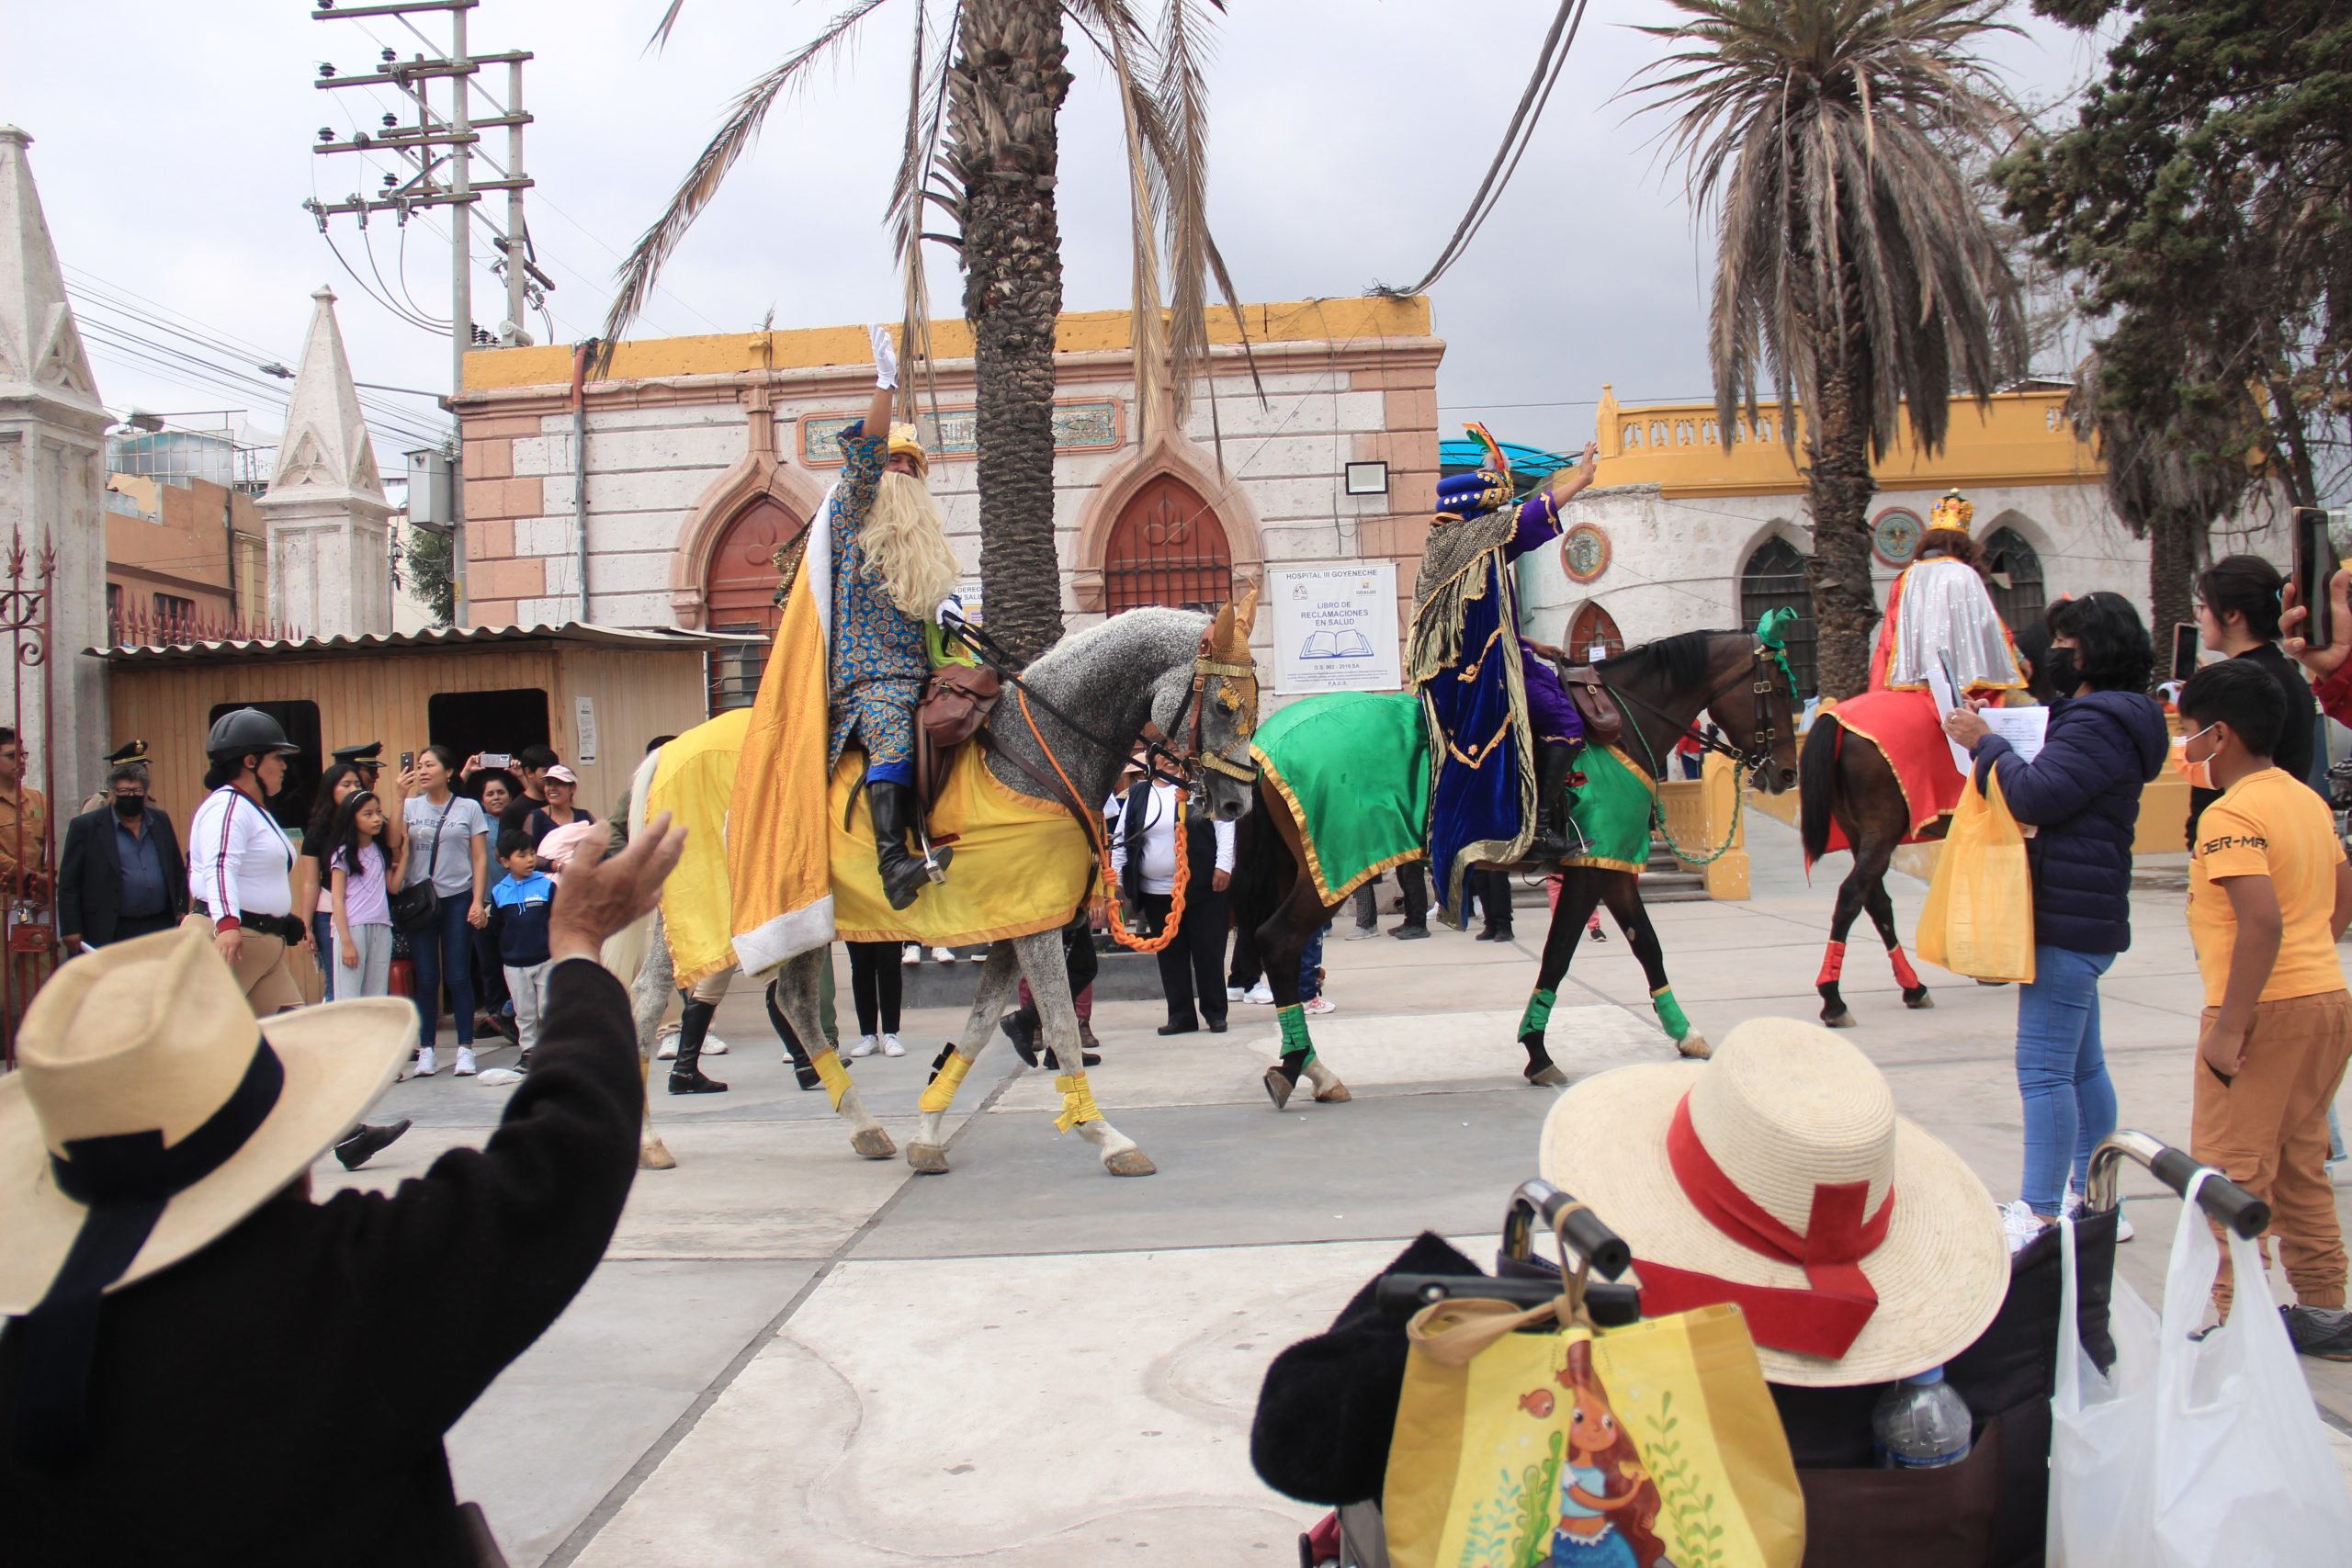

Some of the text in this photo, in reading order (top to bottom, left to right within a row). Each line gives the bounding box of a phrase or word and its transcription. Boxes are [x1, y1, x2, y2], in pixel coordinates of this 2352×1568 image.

[1331, 569, 1378, 578] GOYENECHE
[1300, 609, 1369, 619] RECLAMACIONES
[1315, 617, 1355, 626] EN SALUD
